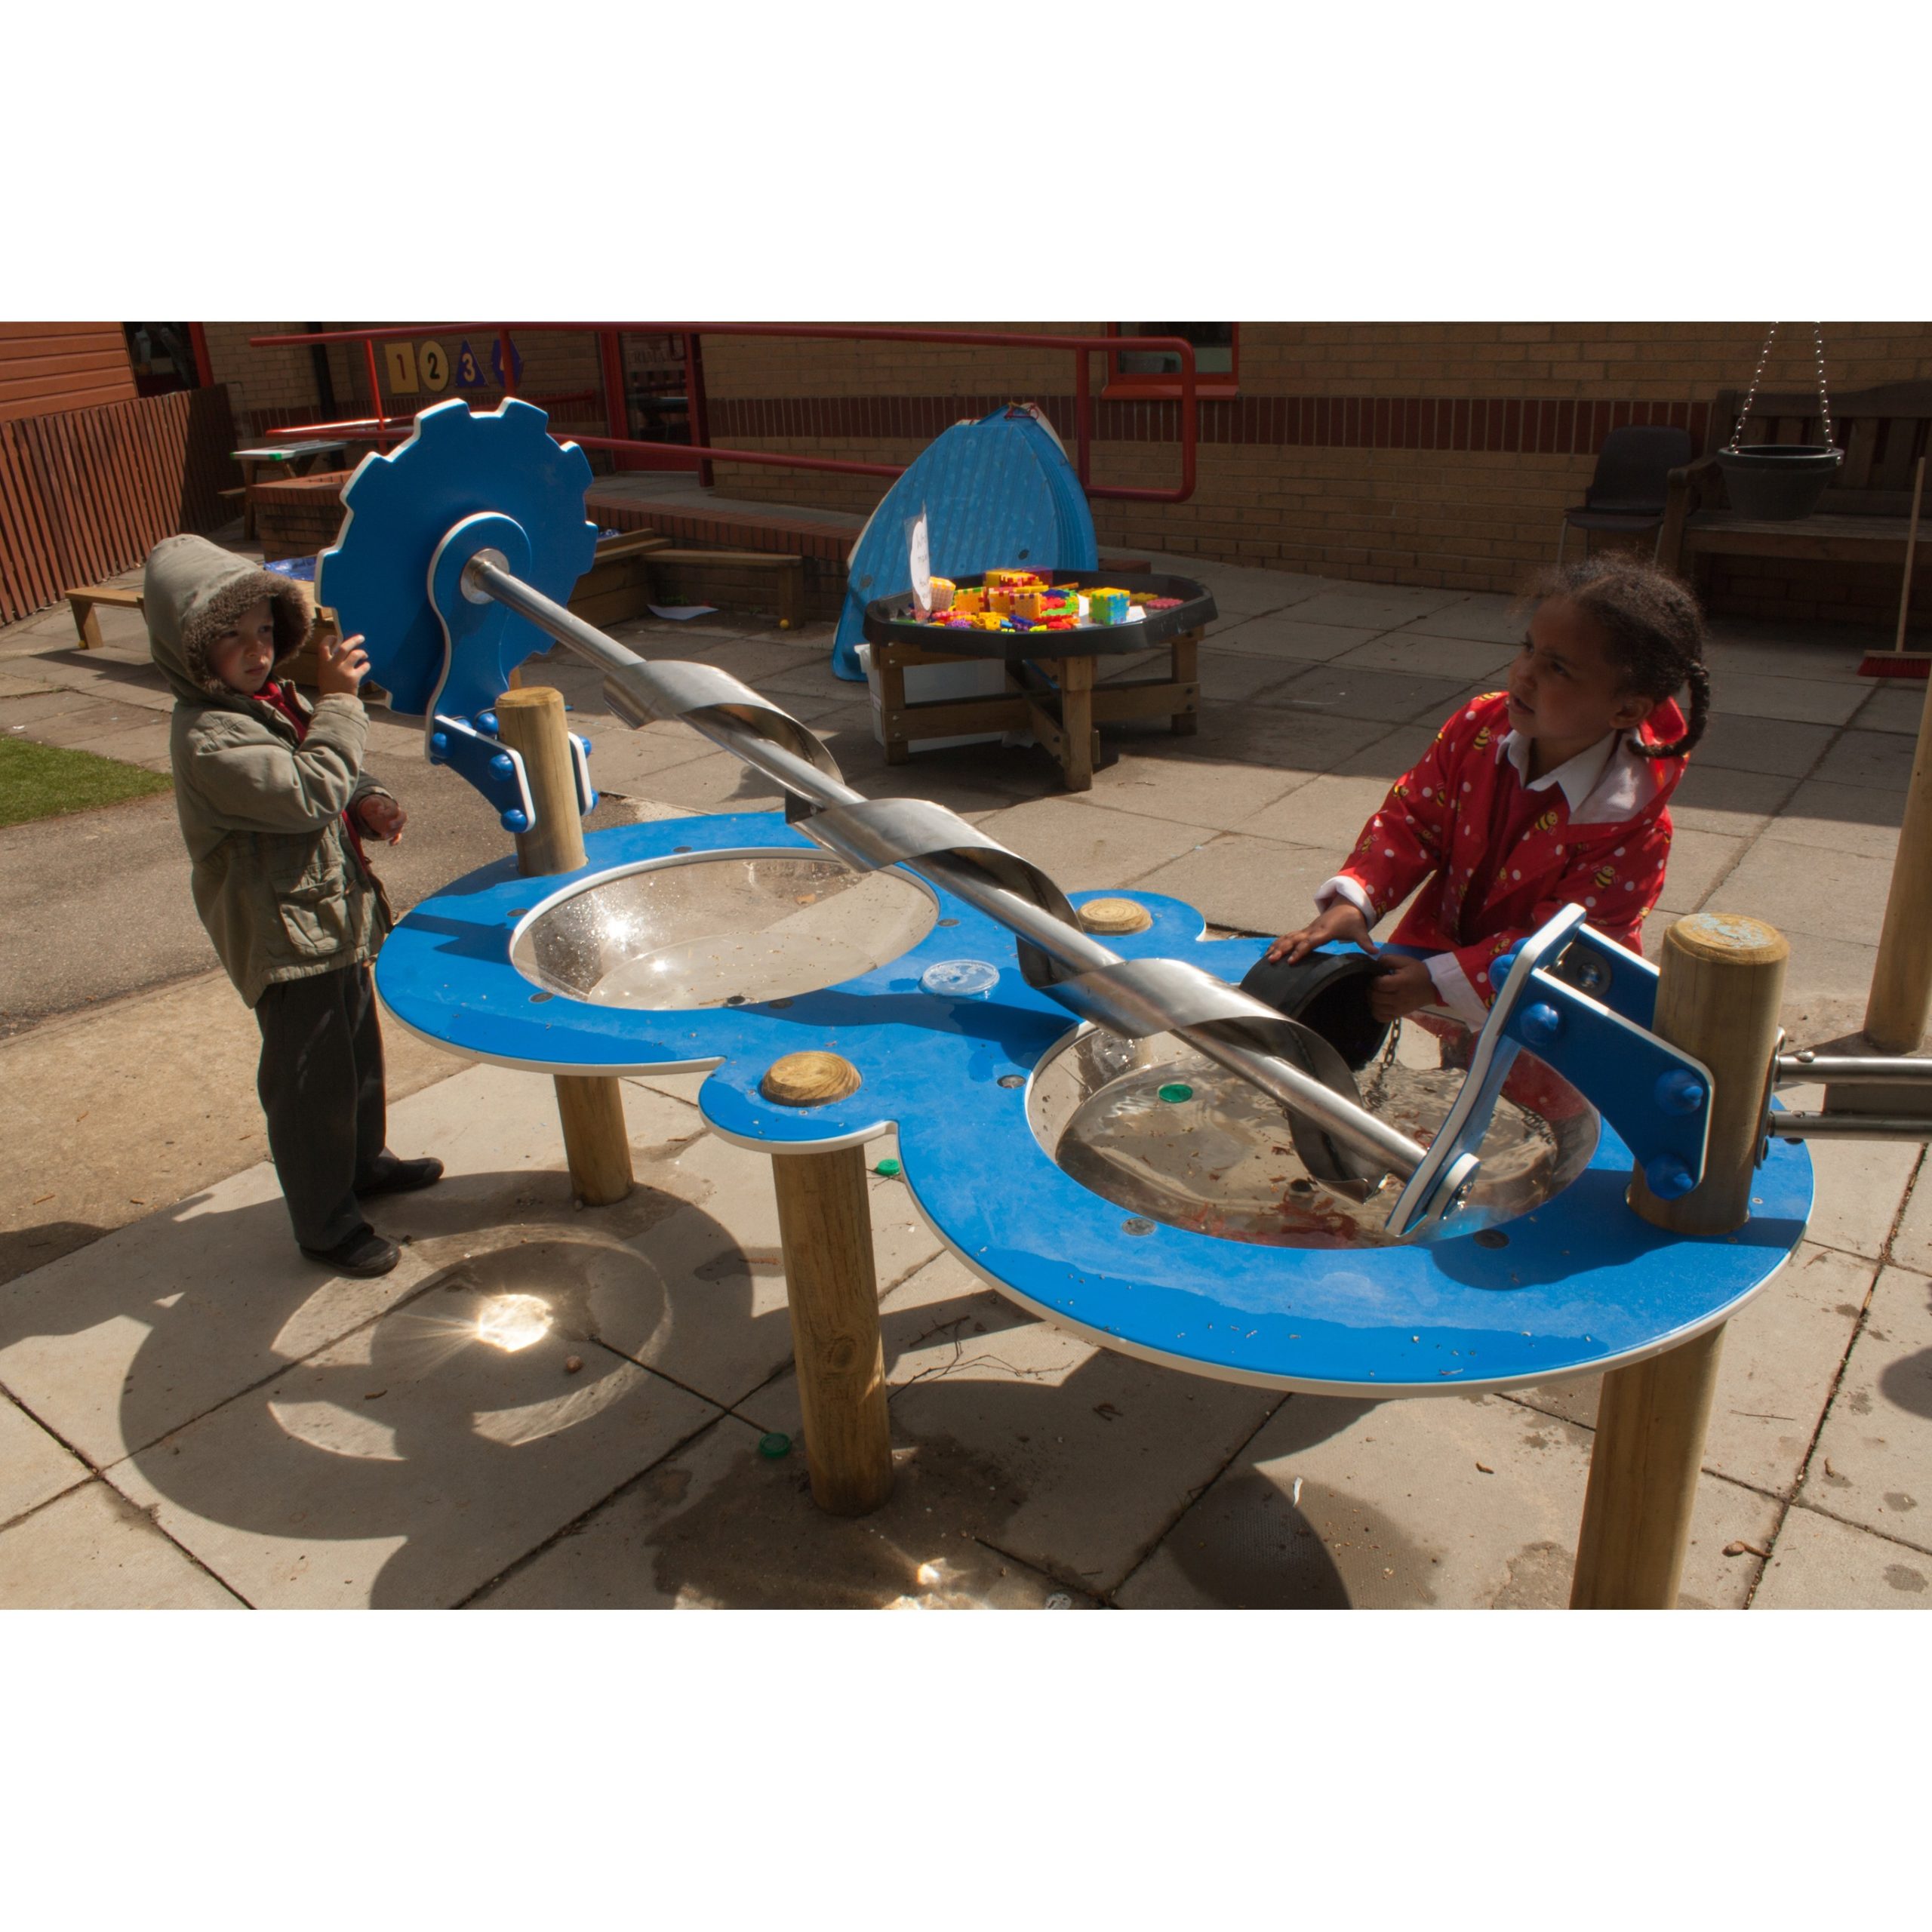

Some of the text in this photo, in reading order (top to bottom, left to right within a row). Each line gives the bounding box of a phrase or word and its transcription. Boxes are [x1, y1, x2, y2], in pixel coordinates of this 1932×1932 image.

[397, 354, 406, 380] 1
[427, 352, 440, 380] 2
[462, 352, 475, 382] 3
